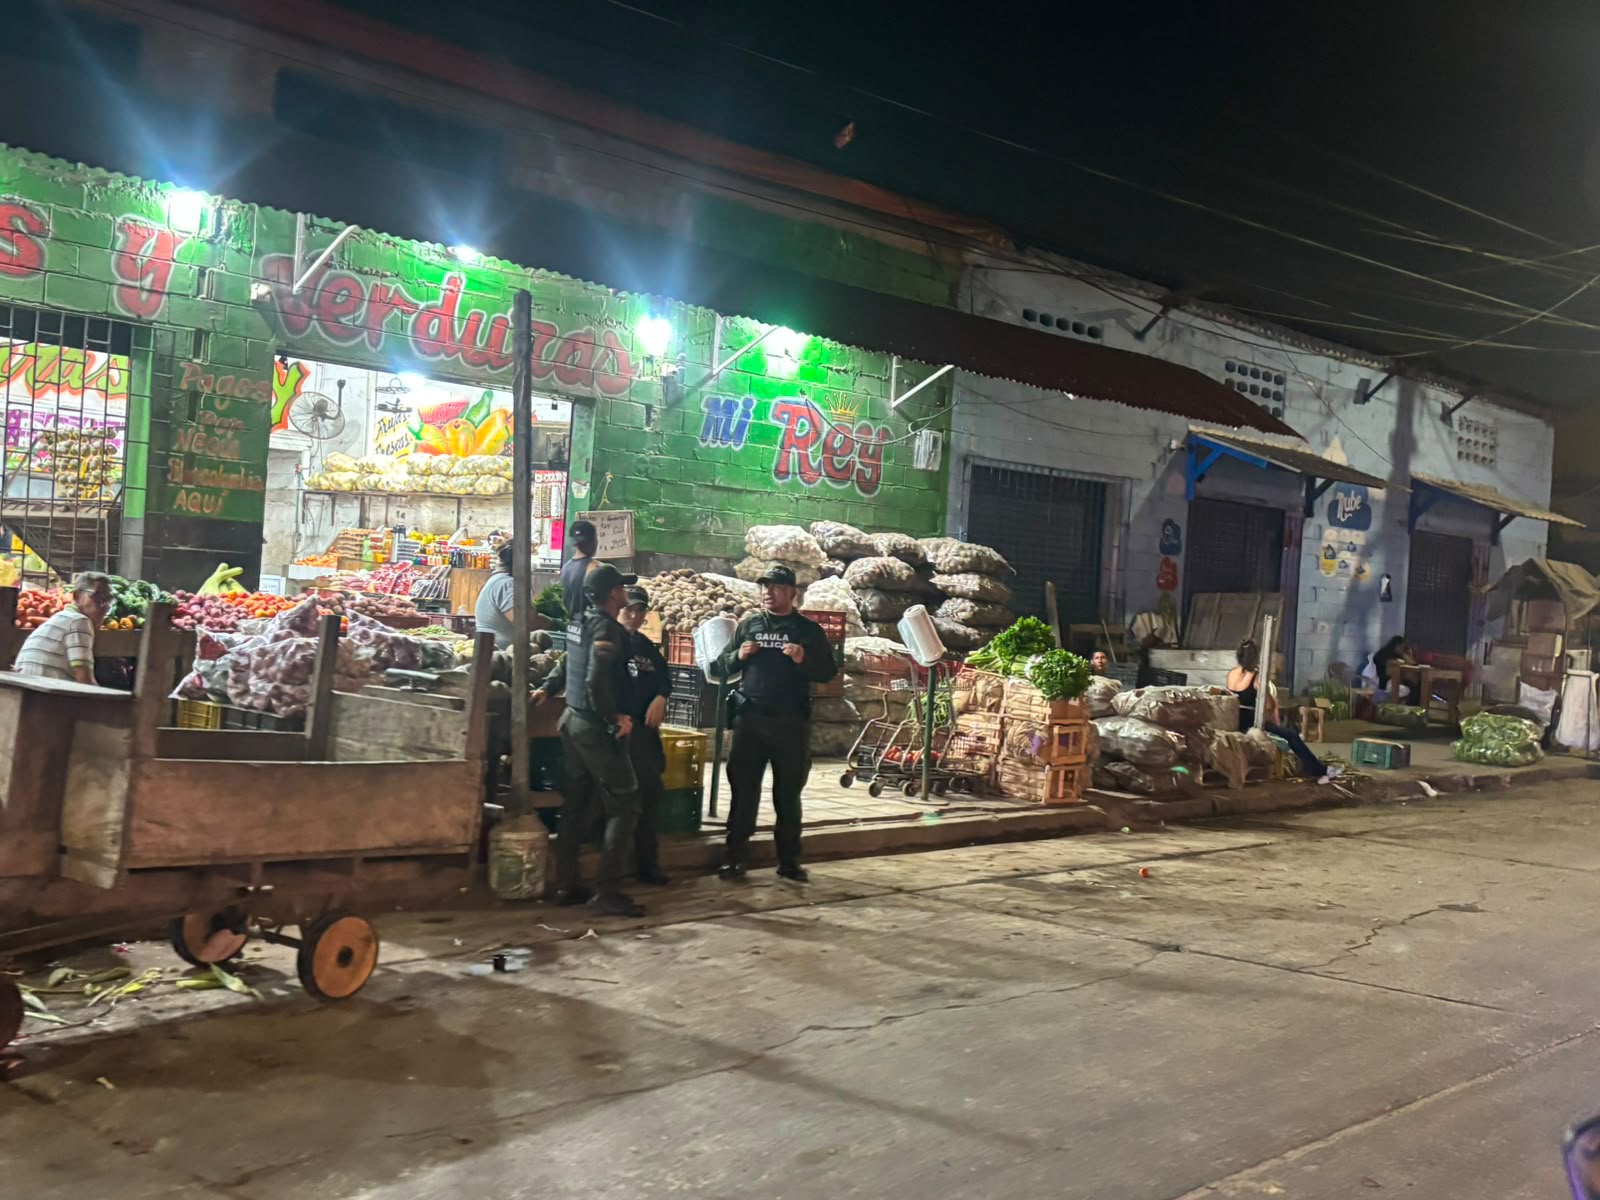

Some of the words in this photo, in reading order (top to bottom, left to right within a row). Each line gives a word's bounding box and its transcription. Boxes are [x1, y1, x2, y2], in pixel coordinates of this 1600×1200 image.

[260, 252, 640, 397] Verduras
[178, 361, 272, 411] Pagos
[769, 397, 896, 497] Rey
[755, 633, 789, 642] GAULA
[756, 641, 785, 650] OLIC
